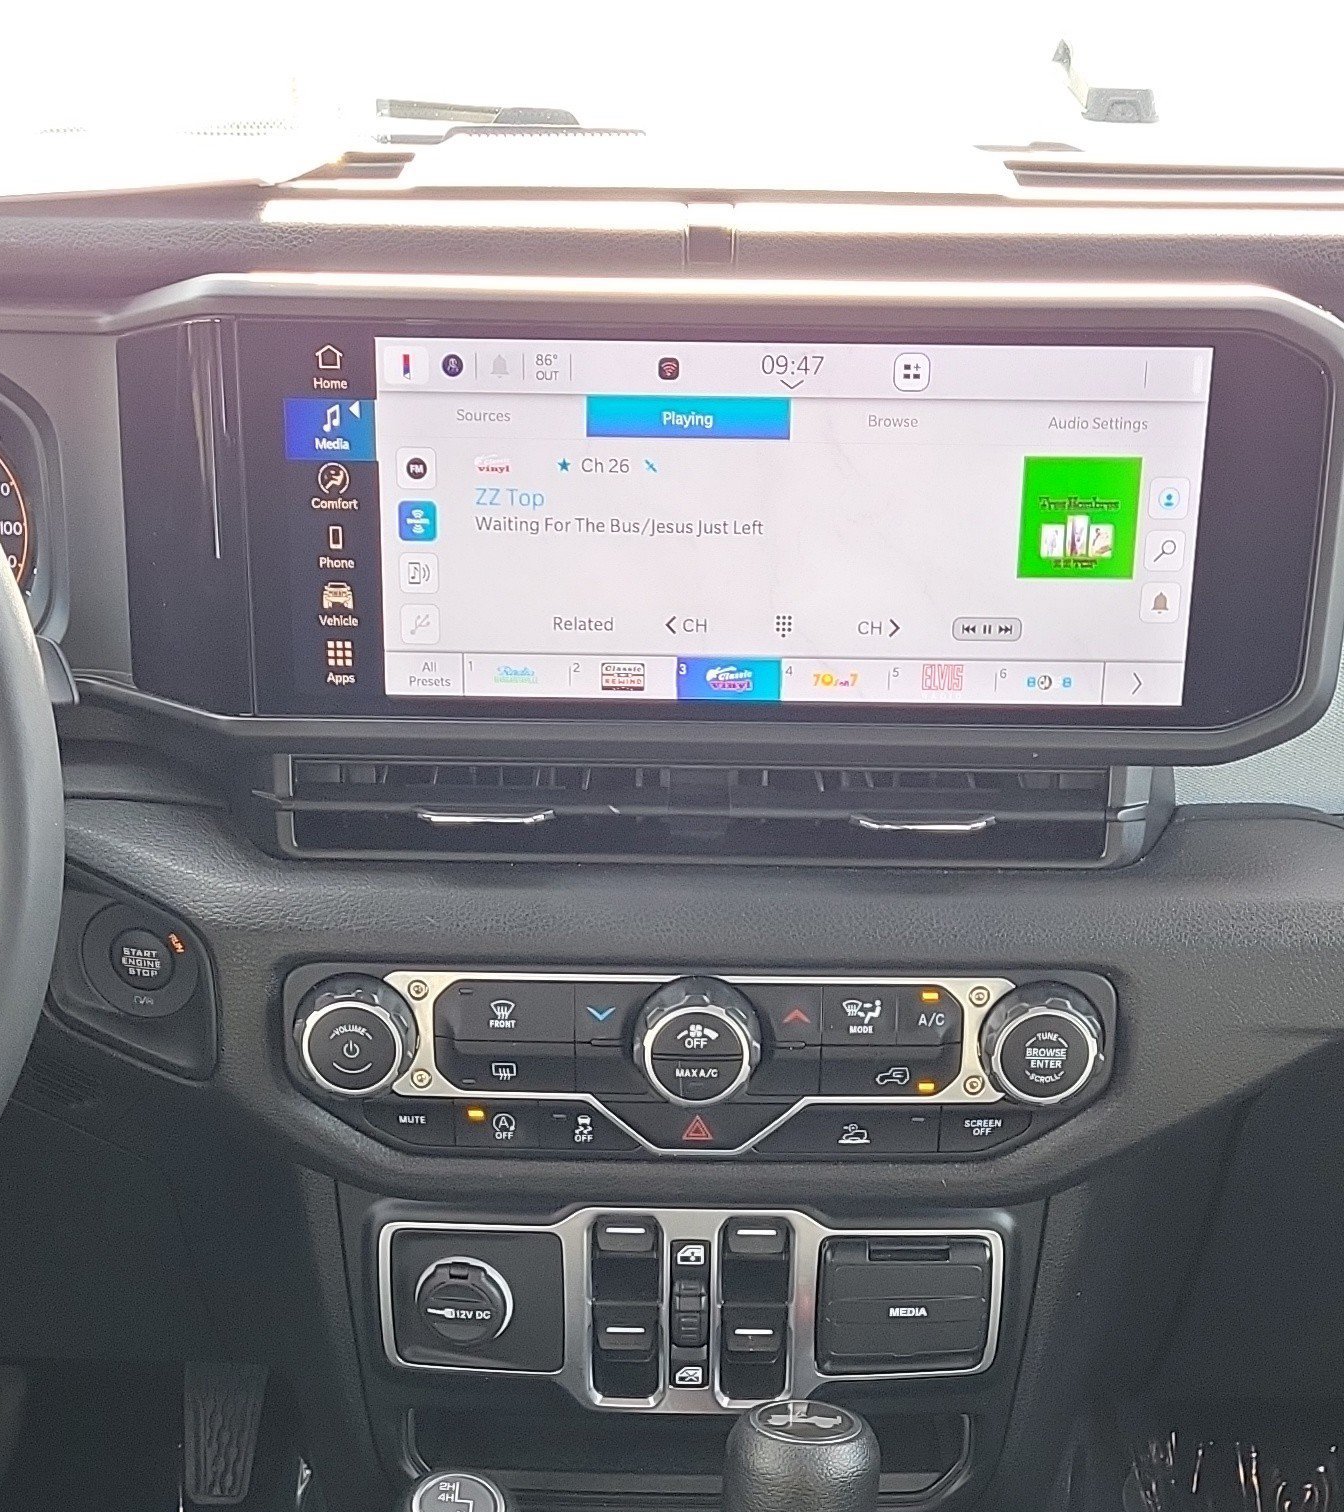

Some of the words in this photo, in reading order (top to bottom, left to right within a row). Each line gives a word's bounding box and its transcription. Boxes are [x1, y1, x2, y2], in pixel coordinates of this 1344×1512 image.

[761, 355, 824, 375] 09:47
[535, 371, 559, 381] OUT
[313, 377, 348, 390] Home
[456, 409, 511, 423] Sources
[662, 411, 713, 429] Playing
[867, 414, 919, 428] Browse
[1048, 416, 1088, 431] Audio
[1092, 417, 1148, 433] Settings
[315, 437, 350, 451] Media
[410, 464, 424, 474] FM
[478, 465, 510, 474] vinyl
[581, 458, 606, 473] Ch
[608, 459, 630, 473] 26
[311, 497, 358, 511] Comfort
[475, 488, 501, 506] ZZ
[506, 489, 545, 511] Top
[0, 521, 22, 536] 100
[475, 516, 540, 535] Waiting
[544, 517, 571, 532] For
[574, 517, 605, 533] The
[610, 518, 693, 536] Bus/Jesus
[696, 519, 729, 536] Just
[733, 520, 763, 536] Left
[319, 556, 355, 569] Phone
[319, 614, 358, 628] Vehicle
[553, 617, 614, 632] Related
[682, 619, 707, 633] CH
[857, 621, 882, 636] CH
[422, 661, 437, 672] All
[573, 663, 580, 673] 2
[679, 664, 687, 675] 3
[785, 666, 793, 676] 4
[892, 667, 900, 677] 5
[327, 672, 355, 685] Apps
[718, 669, 752, 681] Classic
[922, 664, 964, 691] ELVIS
[1000, 669, 1007, 678] 6
[409, 676, 451, 687] Presets
[711, 681, 751, 691] vinyl
[123, 947, 158, 958] START
[122, 957, 161, 968] ENGINE
[128, 968, 158, 977] STOP
[489, 1019, 516, 1029] FRONT
[918, 1013, 945, 1027] A/C
[334, 1026, 368, 1037] VOLUME
[849, 1024, 873, 1034] MODE
[1036, 1032, 1059, 1041] TUNE
[685, 1037, 708, 1049] OFF
[1026, 1048, 1067, 1058] BROWSE
[1030, 1059, 1062, 1070] ENTER
[675, 1068, 697, 1078] MAX
[699, 1068, 718, 1079] A/C
[1029, 1072, 1062, 1083] SCROLL
[398, 1114, 426, 1125] MUTE
[964, 1119, 1002, 1128] SCREEN
[495, 1130, 514, 1140] OFF
[973, 1127, 991, 1136] OFF
[574, 1133, 593, 1143] OFF
[455, 1310, 473, 1320] 12V
[475, 1310, 491, 1320] DC
[889, 1306, 928, 1317] MEDIA
[439, 1482, 456, 1491] 2H
[438, 1493, 454, 1502] 4H
